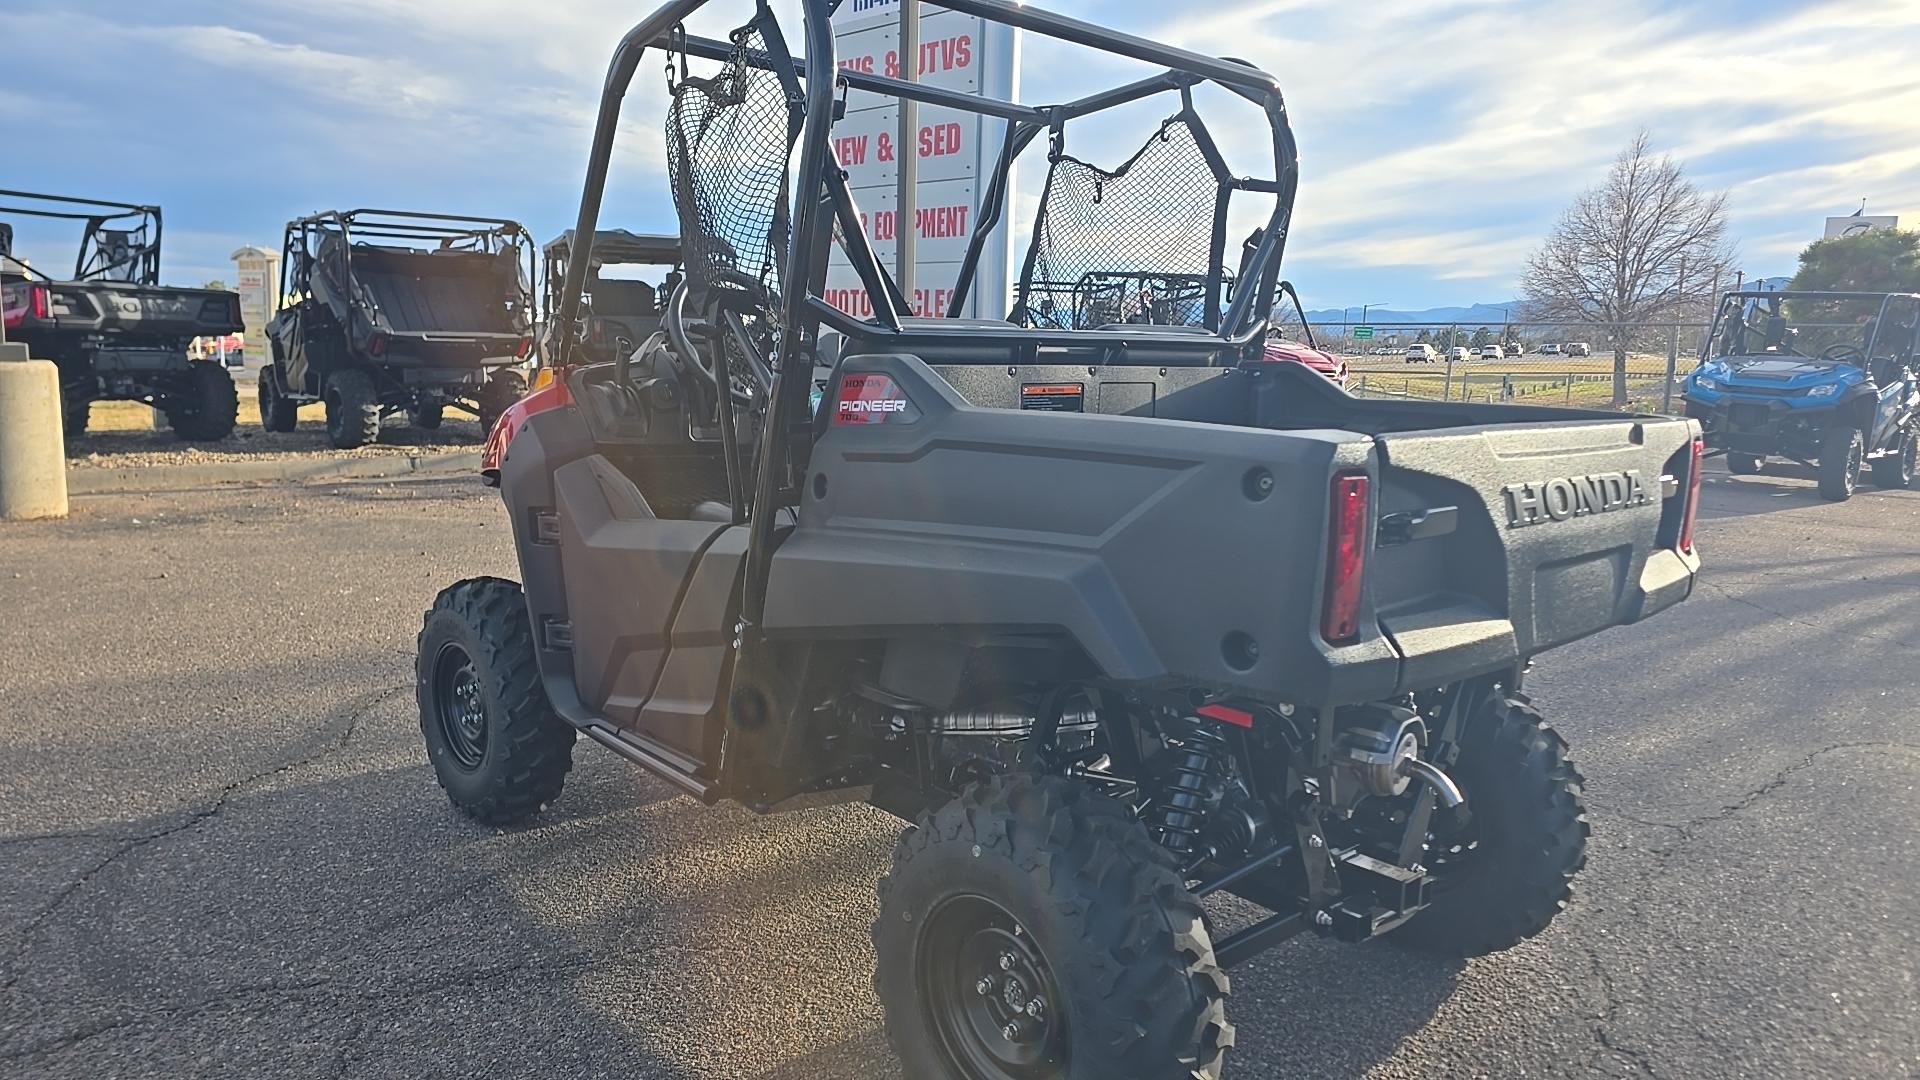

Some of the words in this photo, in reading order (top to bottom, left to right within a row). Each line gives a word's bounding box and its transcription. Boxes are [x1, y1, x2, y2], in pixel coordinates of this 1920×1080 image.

[877, 132, 895, 162] &
[918, 122, 961, 158] SED
[874, 205, 969, 241] EQPMENT
[825, 288, 954, 318] MOTOCLE
[845, 380, 881, 389] HONDA
[839, 399, 907, 413] PIONEER
[1499, 469, 1655, 531] HONDA
